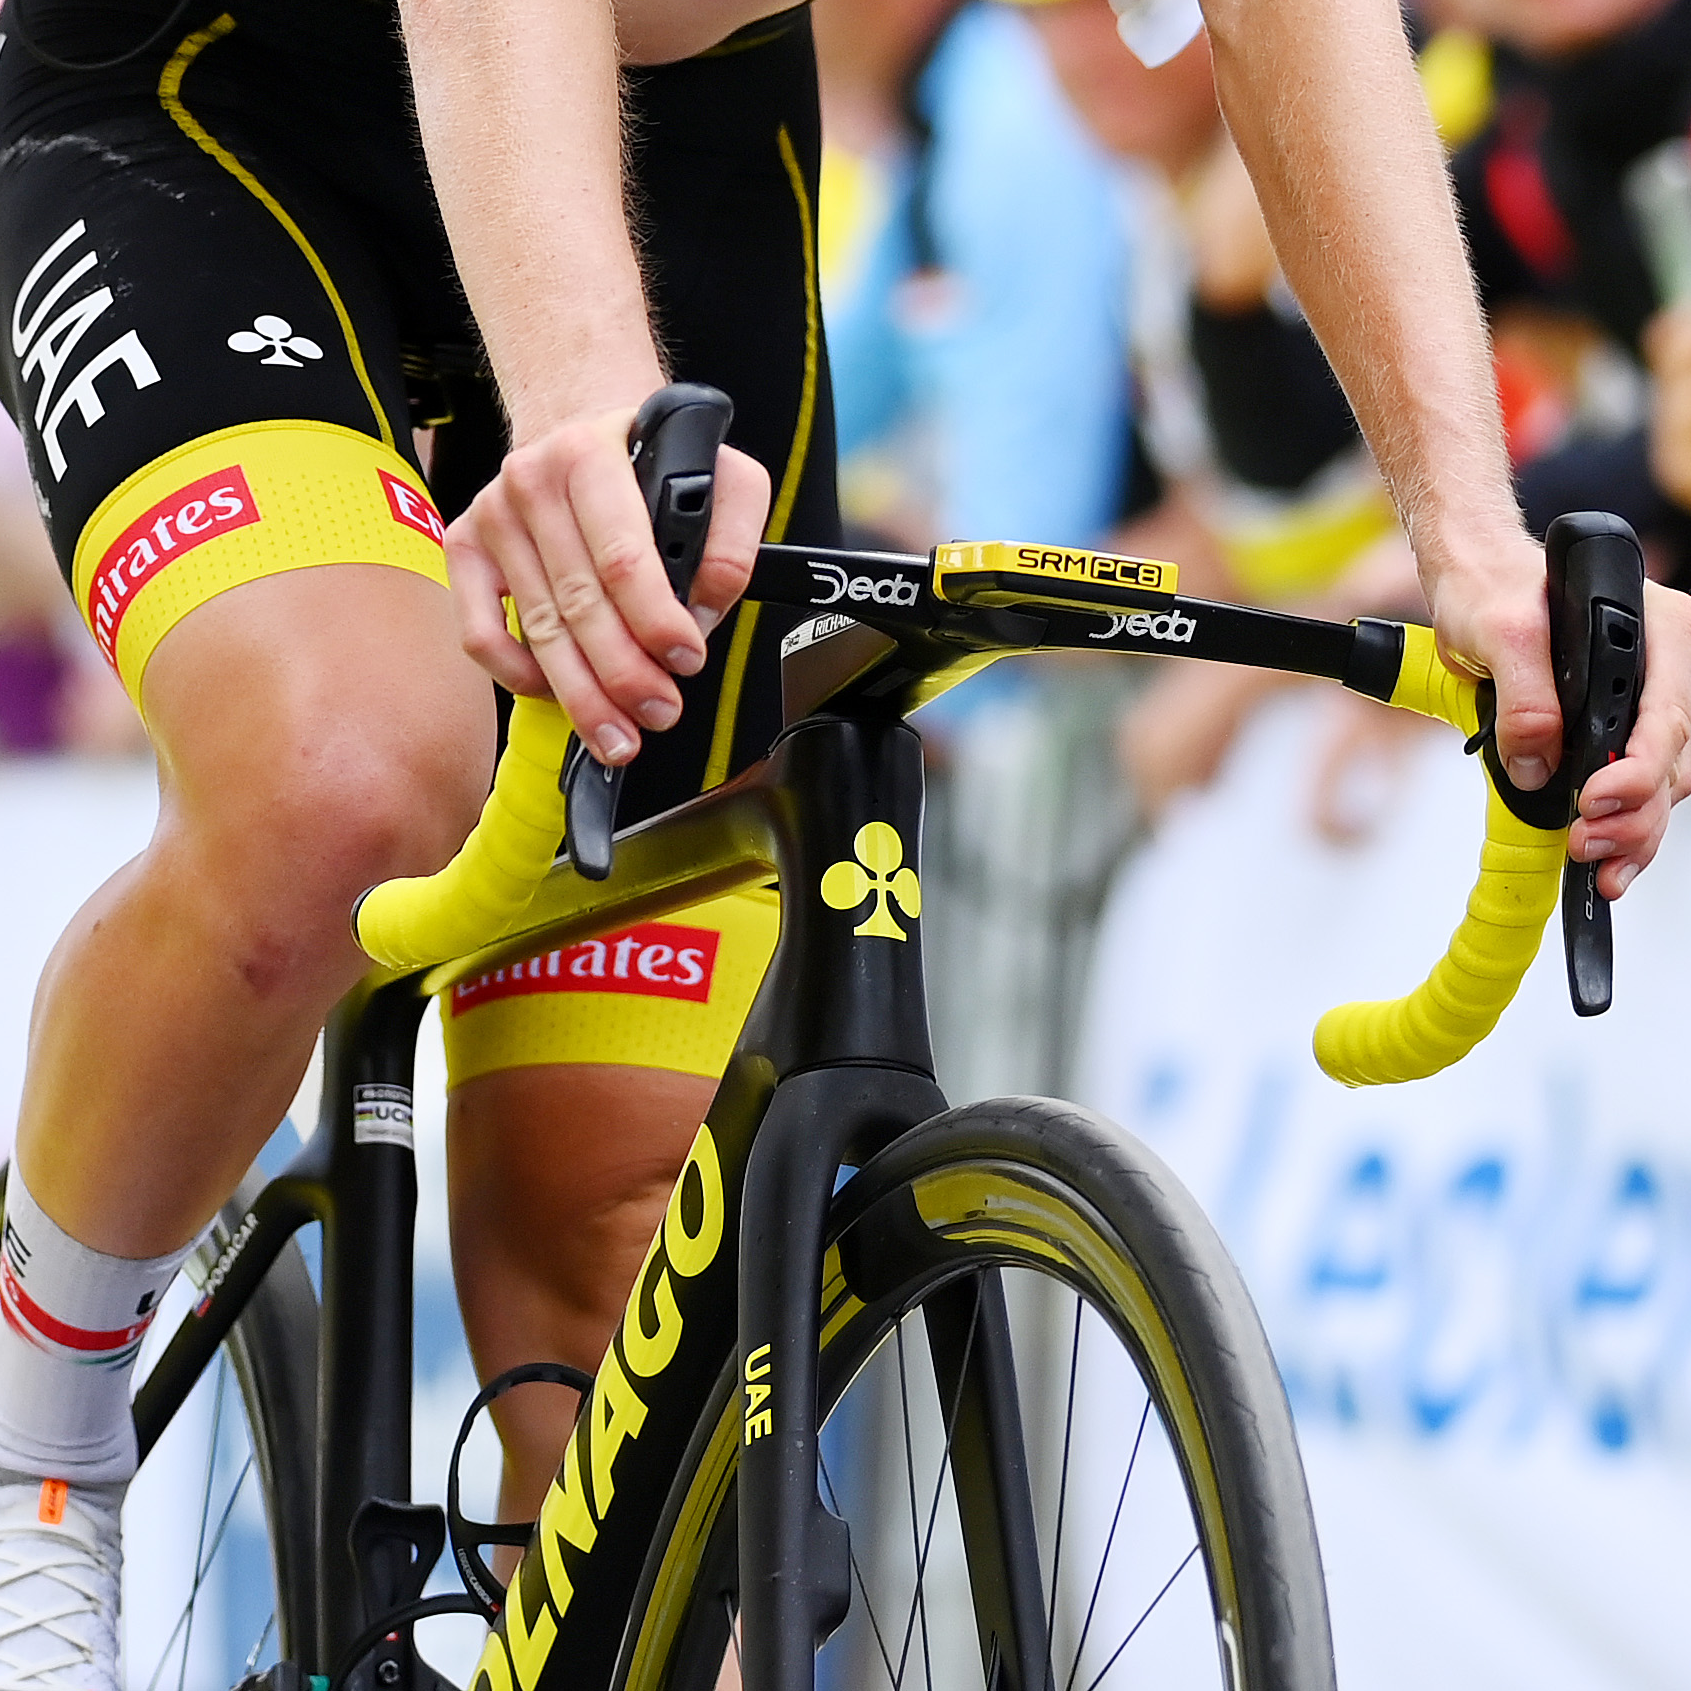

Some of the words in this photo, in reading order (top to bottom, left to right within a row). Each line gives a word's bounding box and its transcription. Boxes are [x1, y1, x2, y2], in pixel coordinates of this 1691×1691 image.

[11, 218, 161, 482] UAE
[1017, 548, 1086, 575] SRM
[1093, 558, 1160, 586] PC8
[745, 1343, 773, 1446] UAE
